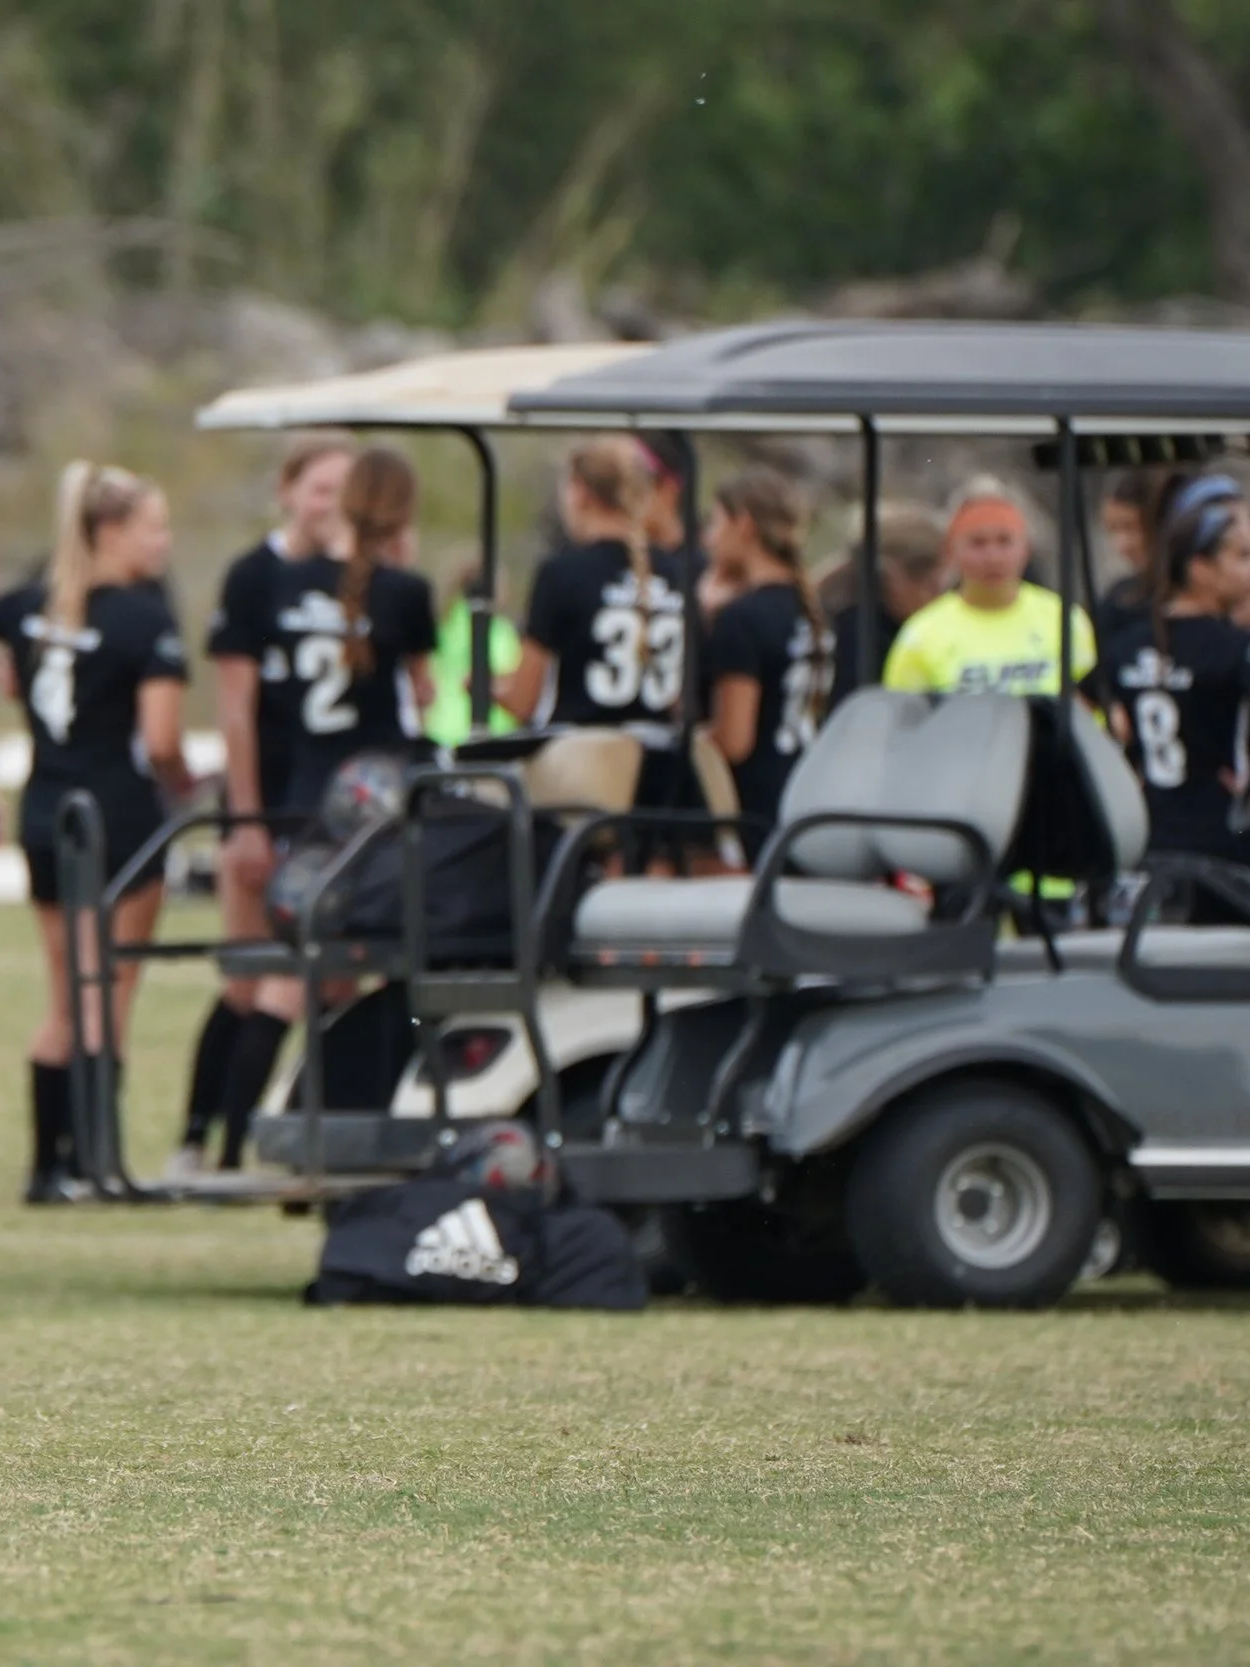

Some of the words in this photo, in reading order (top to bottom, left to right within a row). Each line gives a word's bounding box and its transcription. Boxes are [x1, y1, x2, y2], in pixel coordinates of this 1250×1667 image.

[296, 635, 360, 735] 2
[585, 608, 686, 711] 33
[1136, 691, 1187, 789] 8
